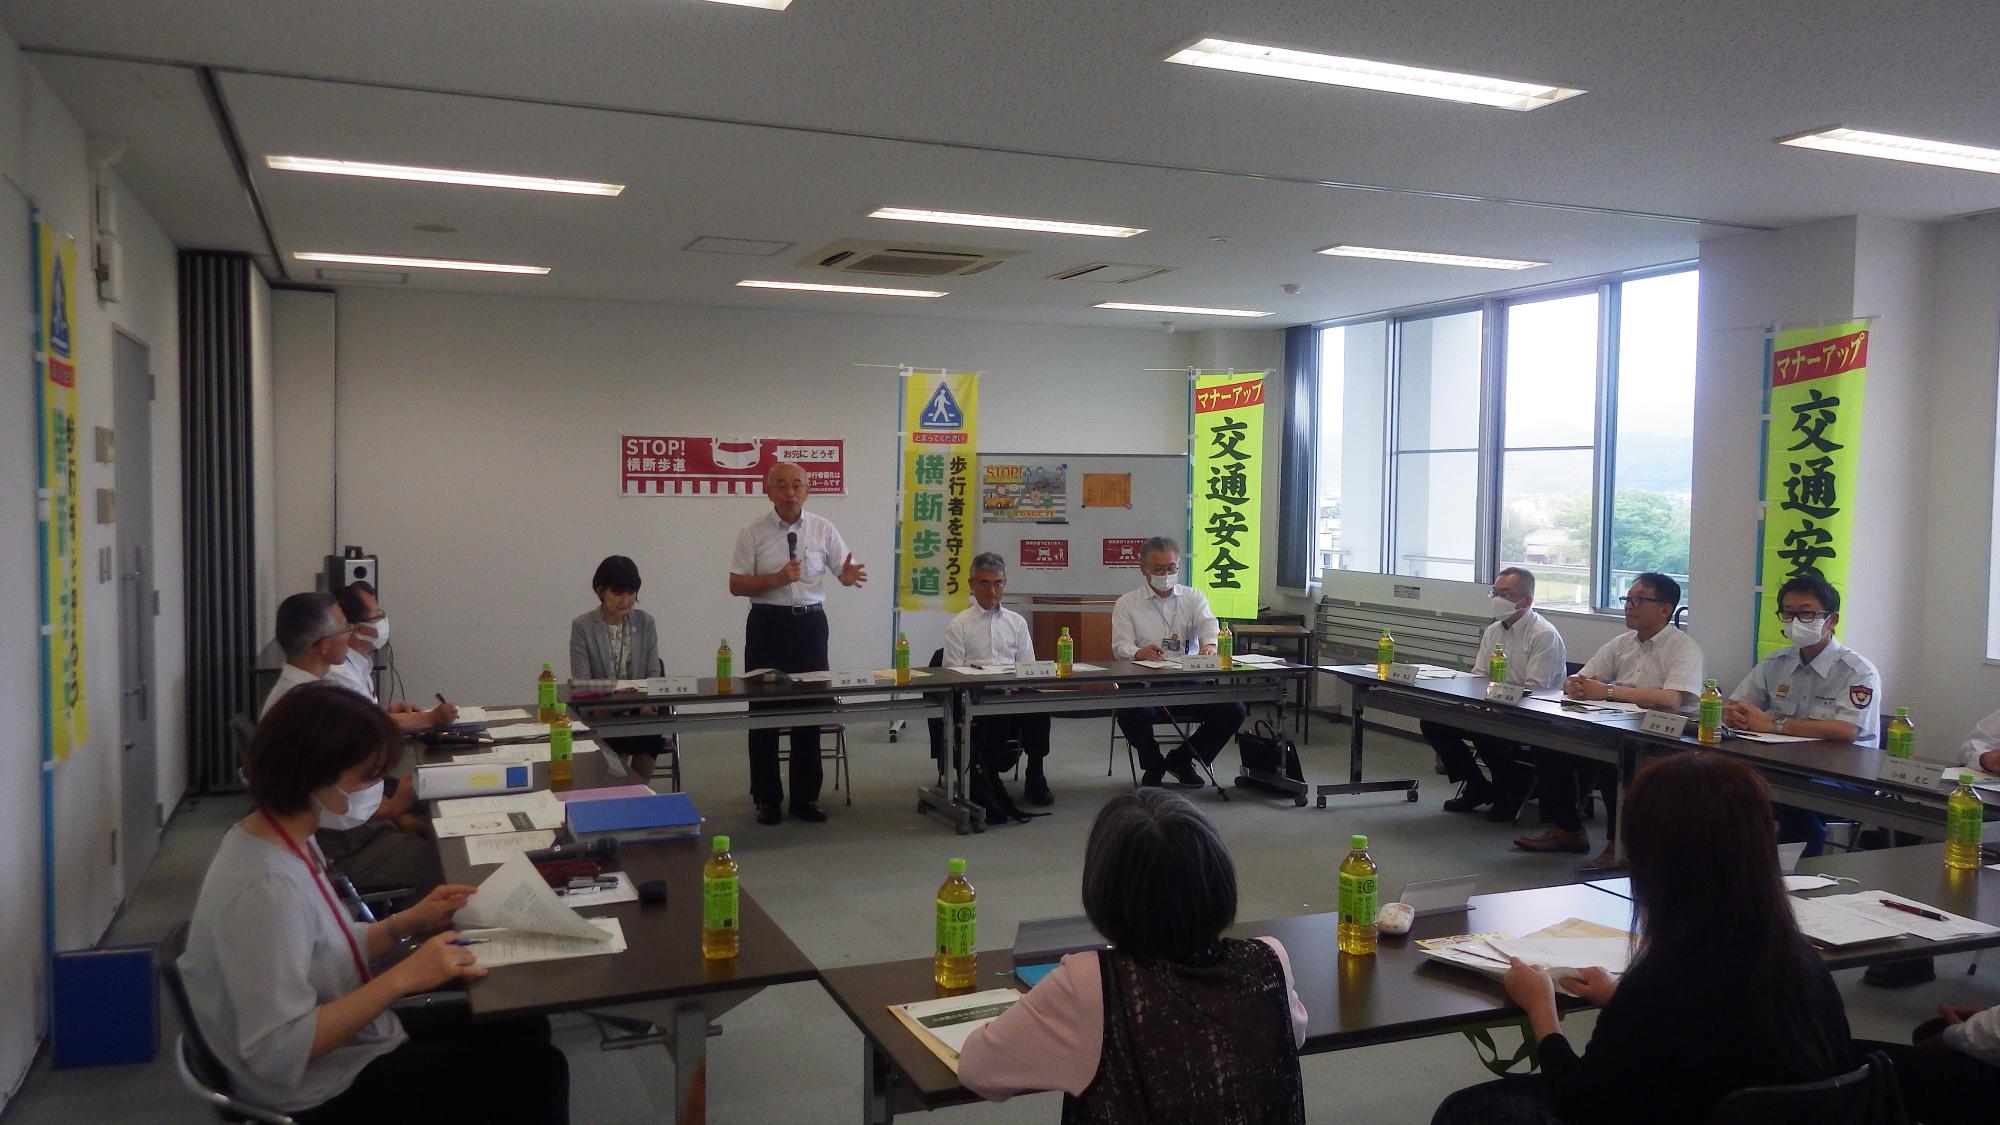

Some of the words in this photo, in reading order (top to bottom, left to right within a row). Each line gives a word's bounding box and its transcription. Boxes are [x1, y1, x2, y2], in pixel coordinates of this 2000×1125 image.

[1776, 333, 1865, 380] マナーアップ
[1197, 382, 1264, 410] マナーアップ
[626, 439, 686, 456] STOP!
[914, 433, 966, 443] とまってください
[627, 457, 687, 472] 横断歩道
[987, 465, 1022, 478] STOP!
[1777, 388, 1844, 577] 交通安
[1204, 416, 1252, 589] 交通安全
[911, 454, 945, 596] 横断歩道
[946, 456, 967, 595] 歩行者を守ろう
